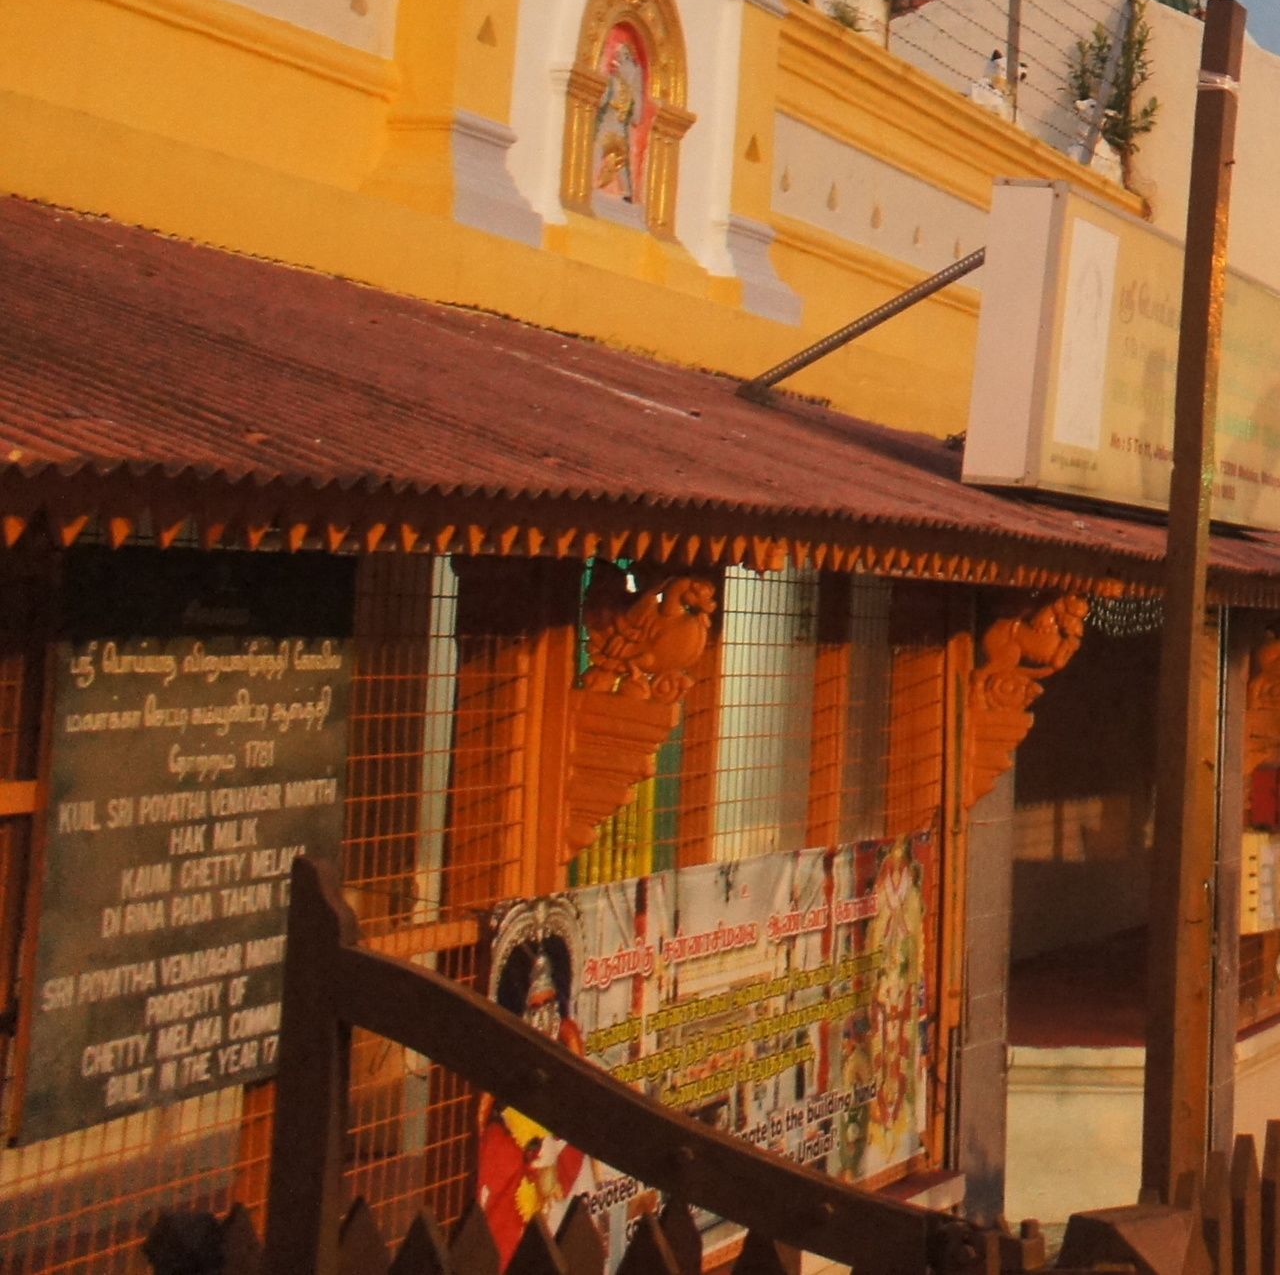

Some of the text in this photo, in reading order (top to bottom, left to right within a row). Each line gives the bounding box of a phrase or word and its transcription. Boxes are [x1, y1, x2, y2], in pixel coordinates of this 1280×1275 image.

[245, 739, 275, 768] 1781
[59, 800, 100, 834] KUIL
[107, 796, 133, 828] SRI
[139, 790, 207, 824] POYATHA
[170, 818, 258, 855] HAK MILIK
[121, 845, 305, 899] KAUM CHETTY MELAK
[171, 892, 213, 927] PADA
[220, 883, 272, 917] TAHUN
[41, 974, 74, 1011] SRI
[246, 934, 287, 969] MOORT
[146, 976, 248, 1024] PROPERTY OF
[81, 1002, 281, 1076] CHETTY MELAKA COMMU
[105, 1067, 154, 1107] BUILT
[159, 1060, 177, 1091] IN
[181, 1051, 211, 1085] THE
[218, 1040, 259, 1074] YEAR
[771, 1117, 783, 1137] to
[786, 1107, 805, 1132] the
[806, 1091, 851, 1125] building
